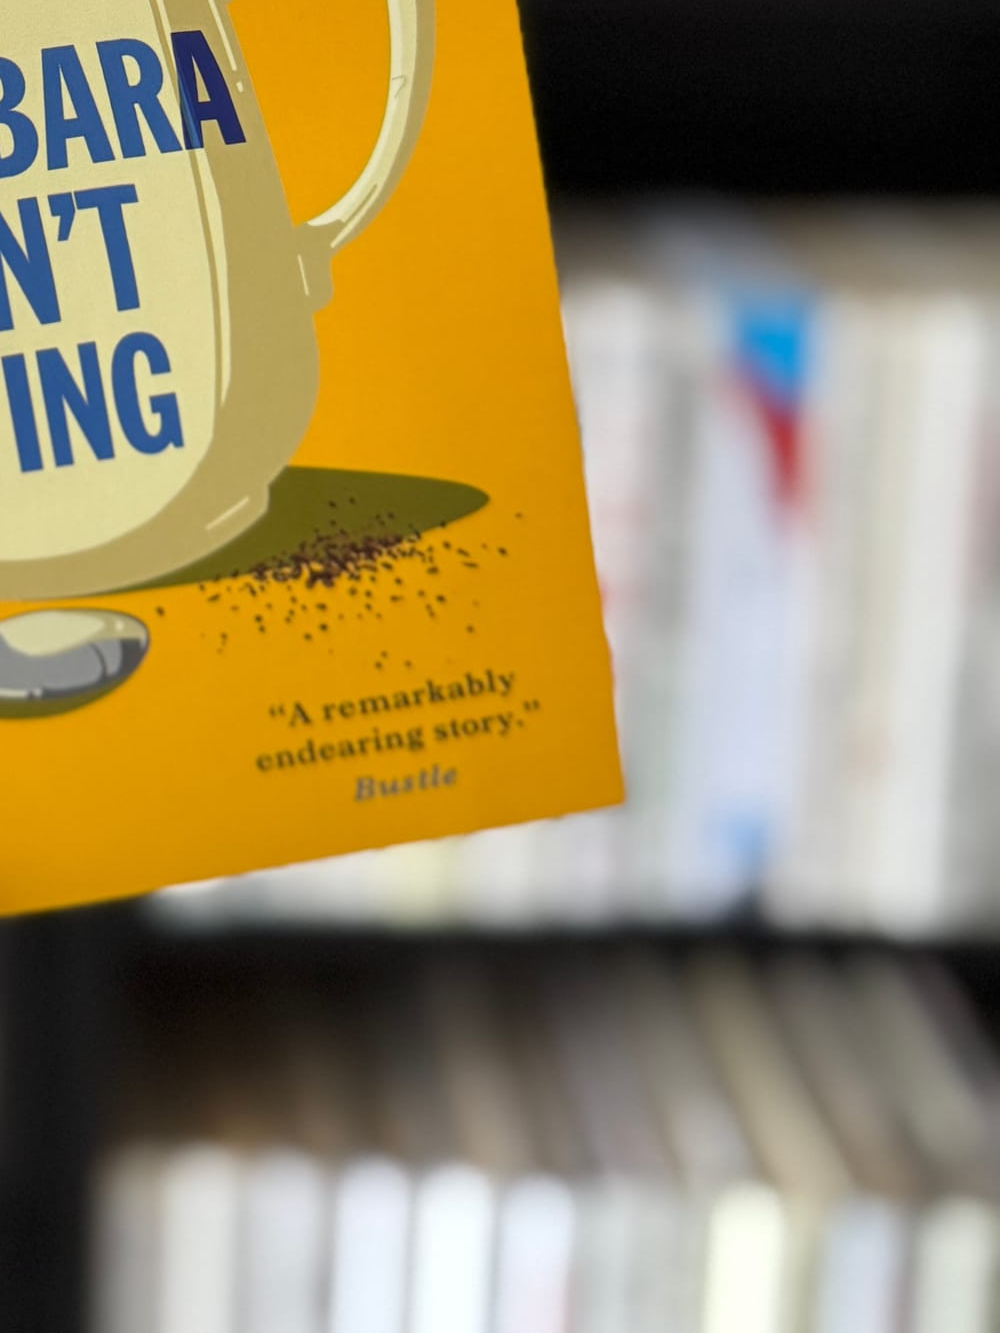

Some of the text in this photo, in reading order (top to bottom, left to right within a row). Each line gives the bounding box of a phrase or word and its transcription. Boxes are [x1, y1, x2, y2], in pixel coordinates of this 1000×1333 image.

[322, 668, 516, 722] remarkably
[255, 726, 425, 772] endearing
[354, 764, 458, 803] Bustle
